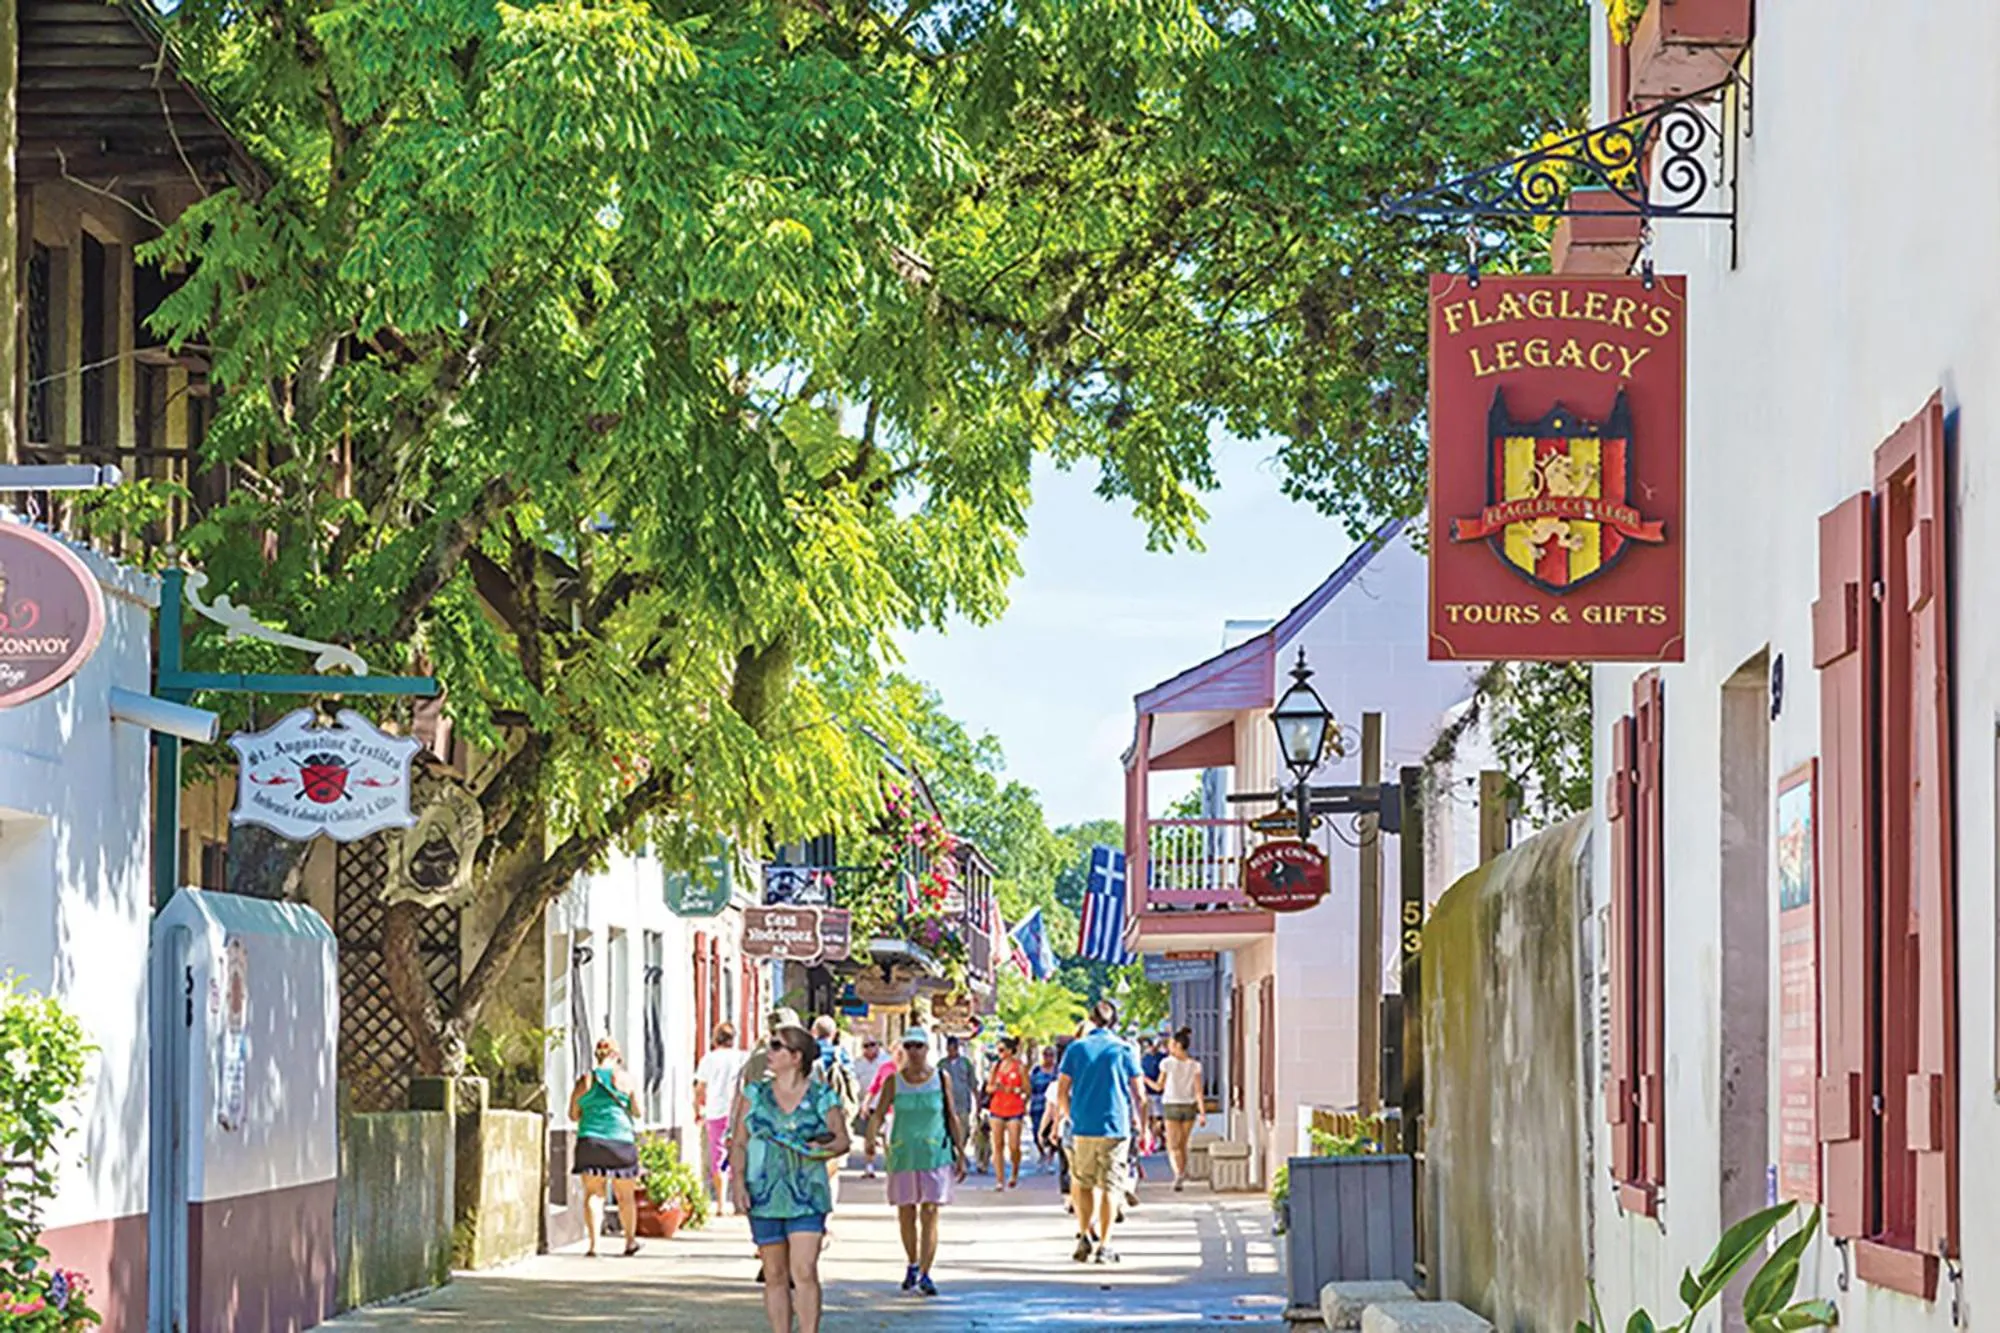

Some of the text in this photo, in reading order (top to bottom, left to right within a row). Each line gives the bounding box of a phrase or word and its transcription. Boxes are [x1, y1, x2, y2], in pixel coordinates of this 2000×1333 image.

[1443, 289, 1672, 337] FLAGLER'S
[1469, 338, 1651, 378] LEGACY
[1485, 497, 1553, 526] FLAGLER
[1446, 604, 1667, 624] TOURS & GIFTS
[275, 737, 346, 757] Augustine
[350, 738, 401, 770] Textiles
